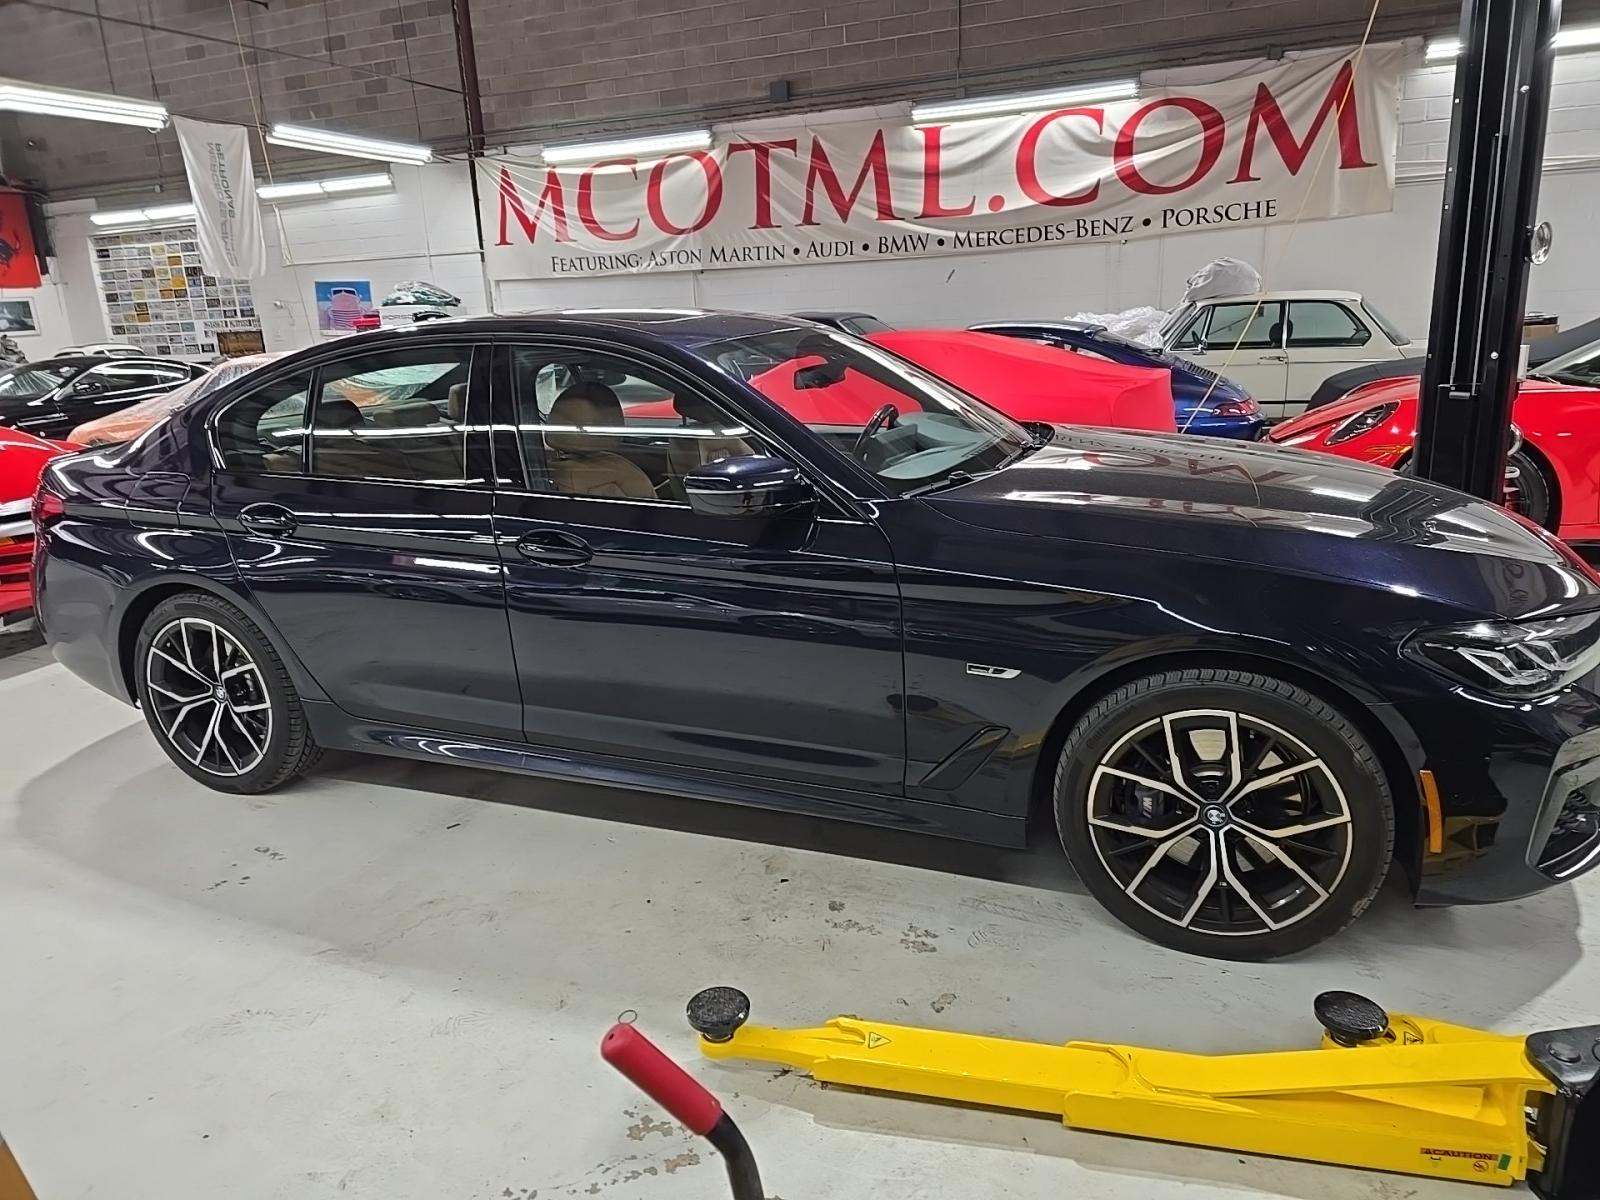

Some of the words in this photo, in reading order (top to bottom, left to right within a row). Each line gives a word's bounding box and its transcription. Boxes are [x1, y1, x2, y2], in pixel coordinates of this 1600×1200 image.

[495, 60, 1377, 246] MCOTML.COM
[552, 253, 643, 273] FEATURING:
[649, 249, 702, 267] ASTON
[709, 244, 785, 263] MARTIN
[806, 239, 854, 258] AUDI
[878, 233, 930, 254] BMW
[952, 216, 1135, 248] MERCEDES-BENZ
[1161, 199, 1278, 228] PORSCHE
[1433, 1149, 1493, 1161] CAUTION
